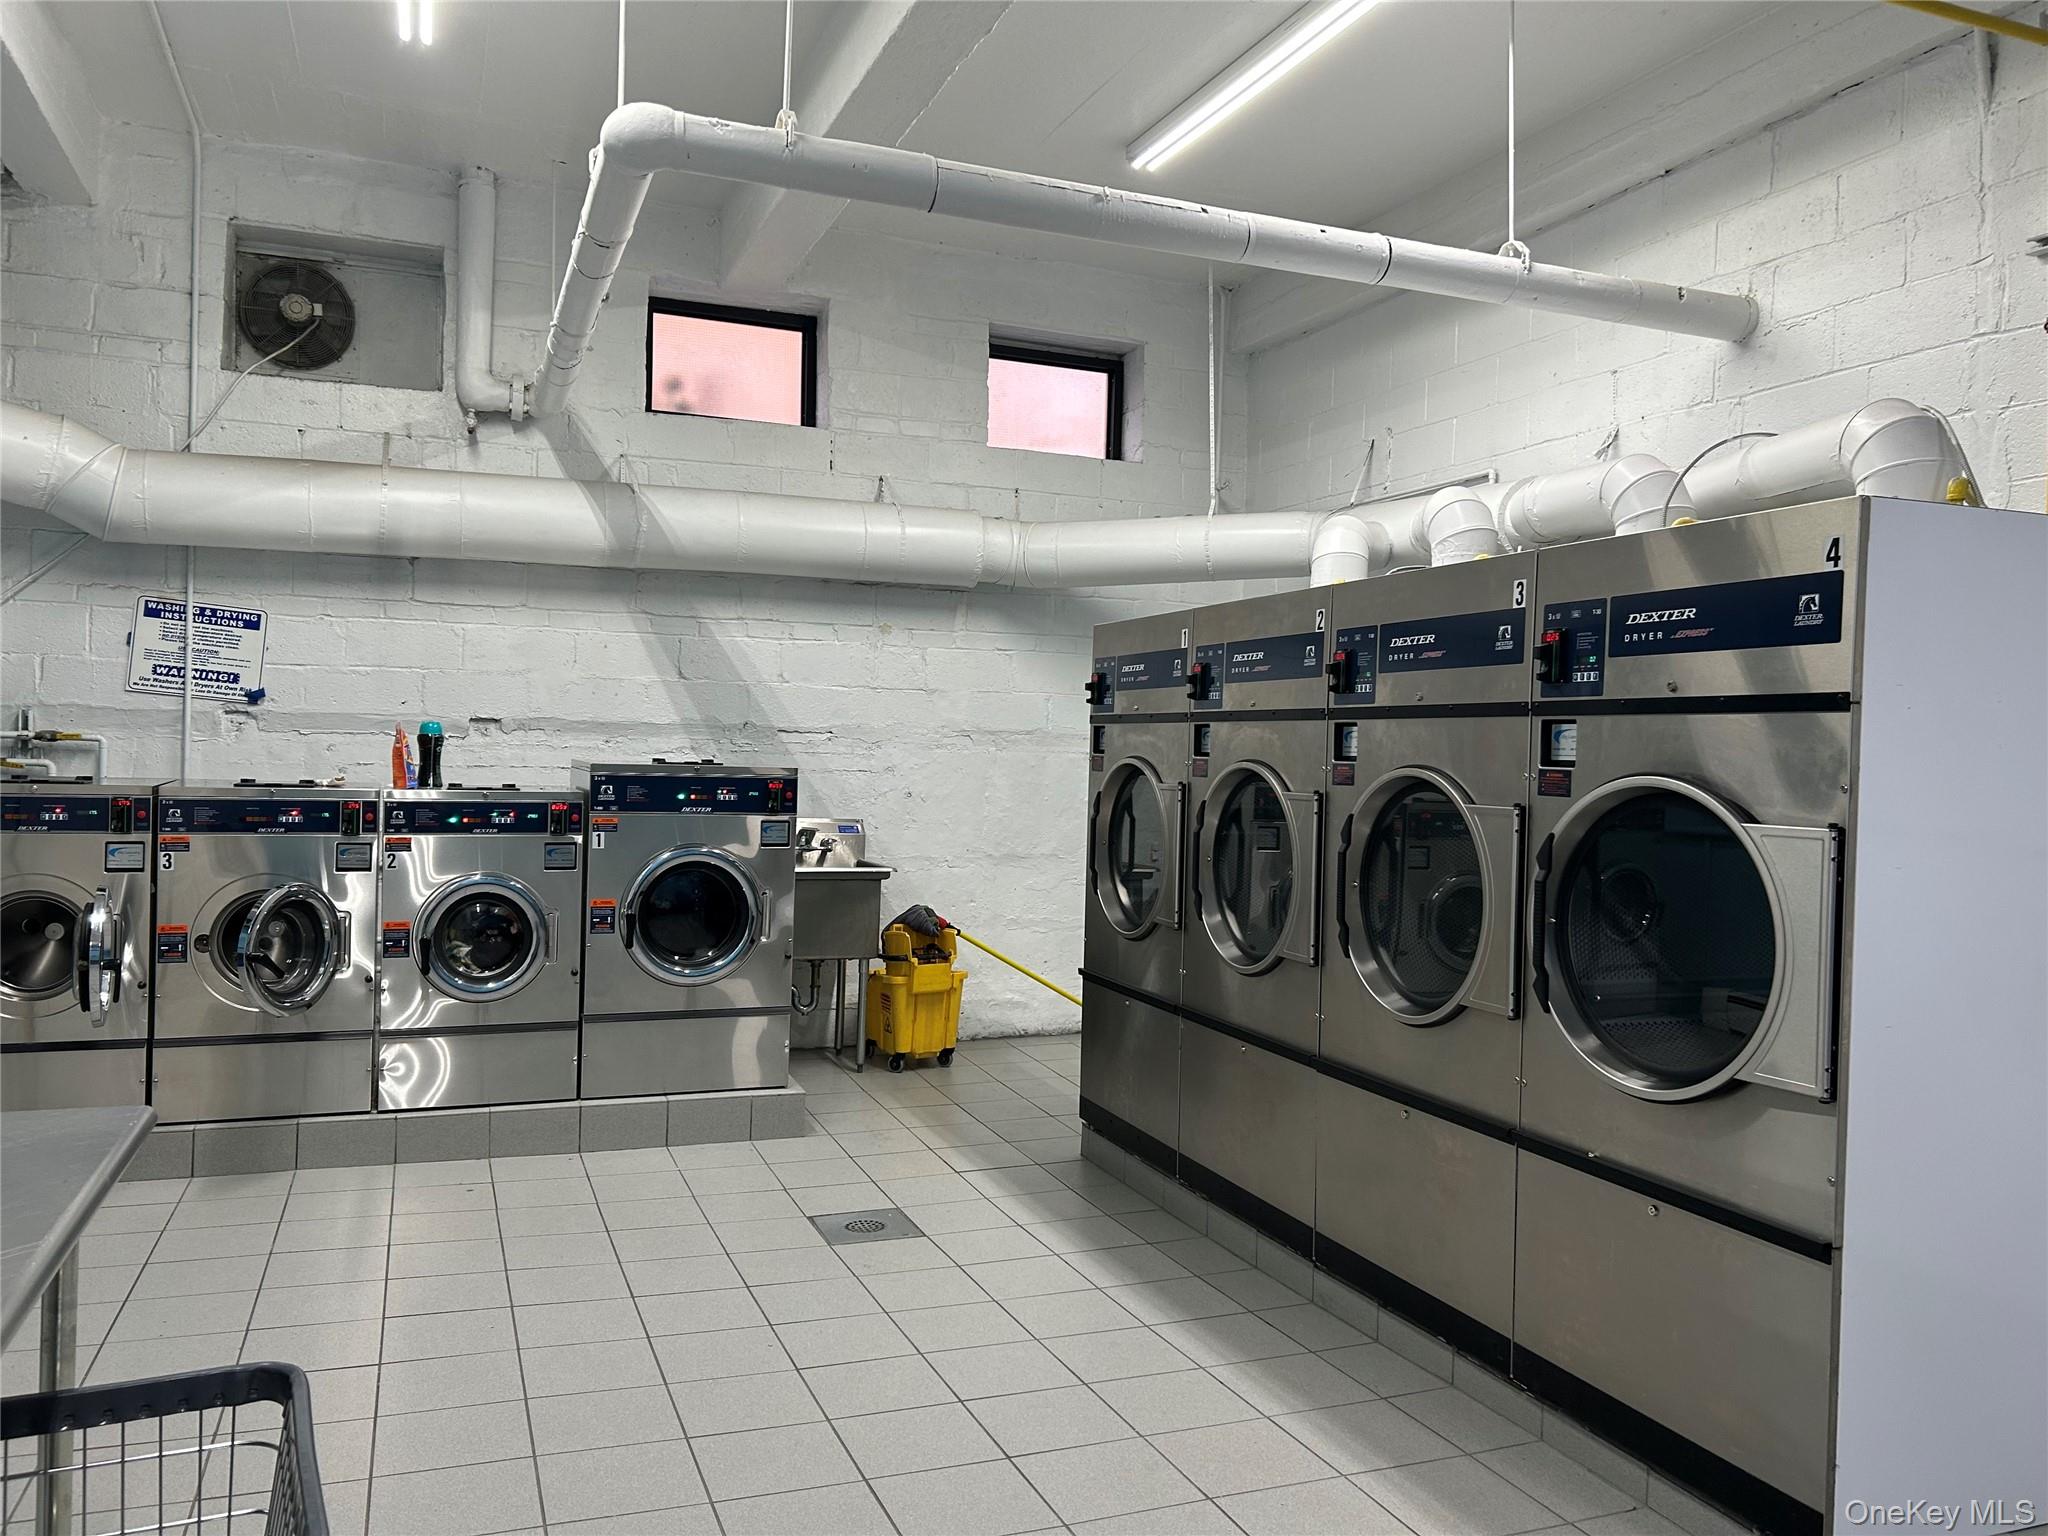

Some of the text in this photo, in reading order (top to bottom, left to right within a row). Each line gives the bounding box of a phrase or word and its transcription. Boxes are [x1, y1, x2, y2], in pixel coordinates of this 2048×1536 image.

[1826, 537, 1841, 568] 4
[1515, 581, 1524, 606] 3
[147, 601, 200, 614] WASHIG
[216, 610, 258, 621] DRYING
[1625, 608, 1697, 625] DEXTER
[160, 611, 244, 628] INSTUCTIONS
[1316, 610, 1324, 631] 2
[1183, 630, 1187, 647] 1
[1389, 634, 1436, 648] DEXTER
[1624, 631, 1663, 642] DRYER
[1232, 651, 1265, 662] DEXTER
[1388, 652, 1414, 661] DRYER
[1121, 664, 1145, 673] DEXTER
[1231, 666, 1250, 674] DRYER
[595, 833, 601, 848] 1
[162, 852, 172, 870] 3
[387, 853, 397, 869] 2
